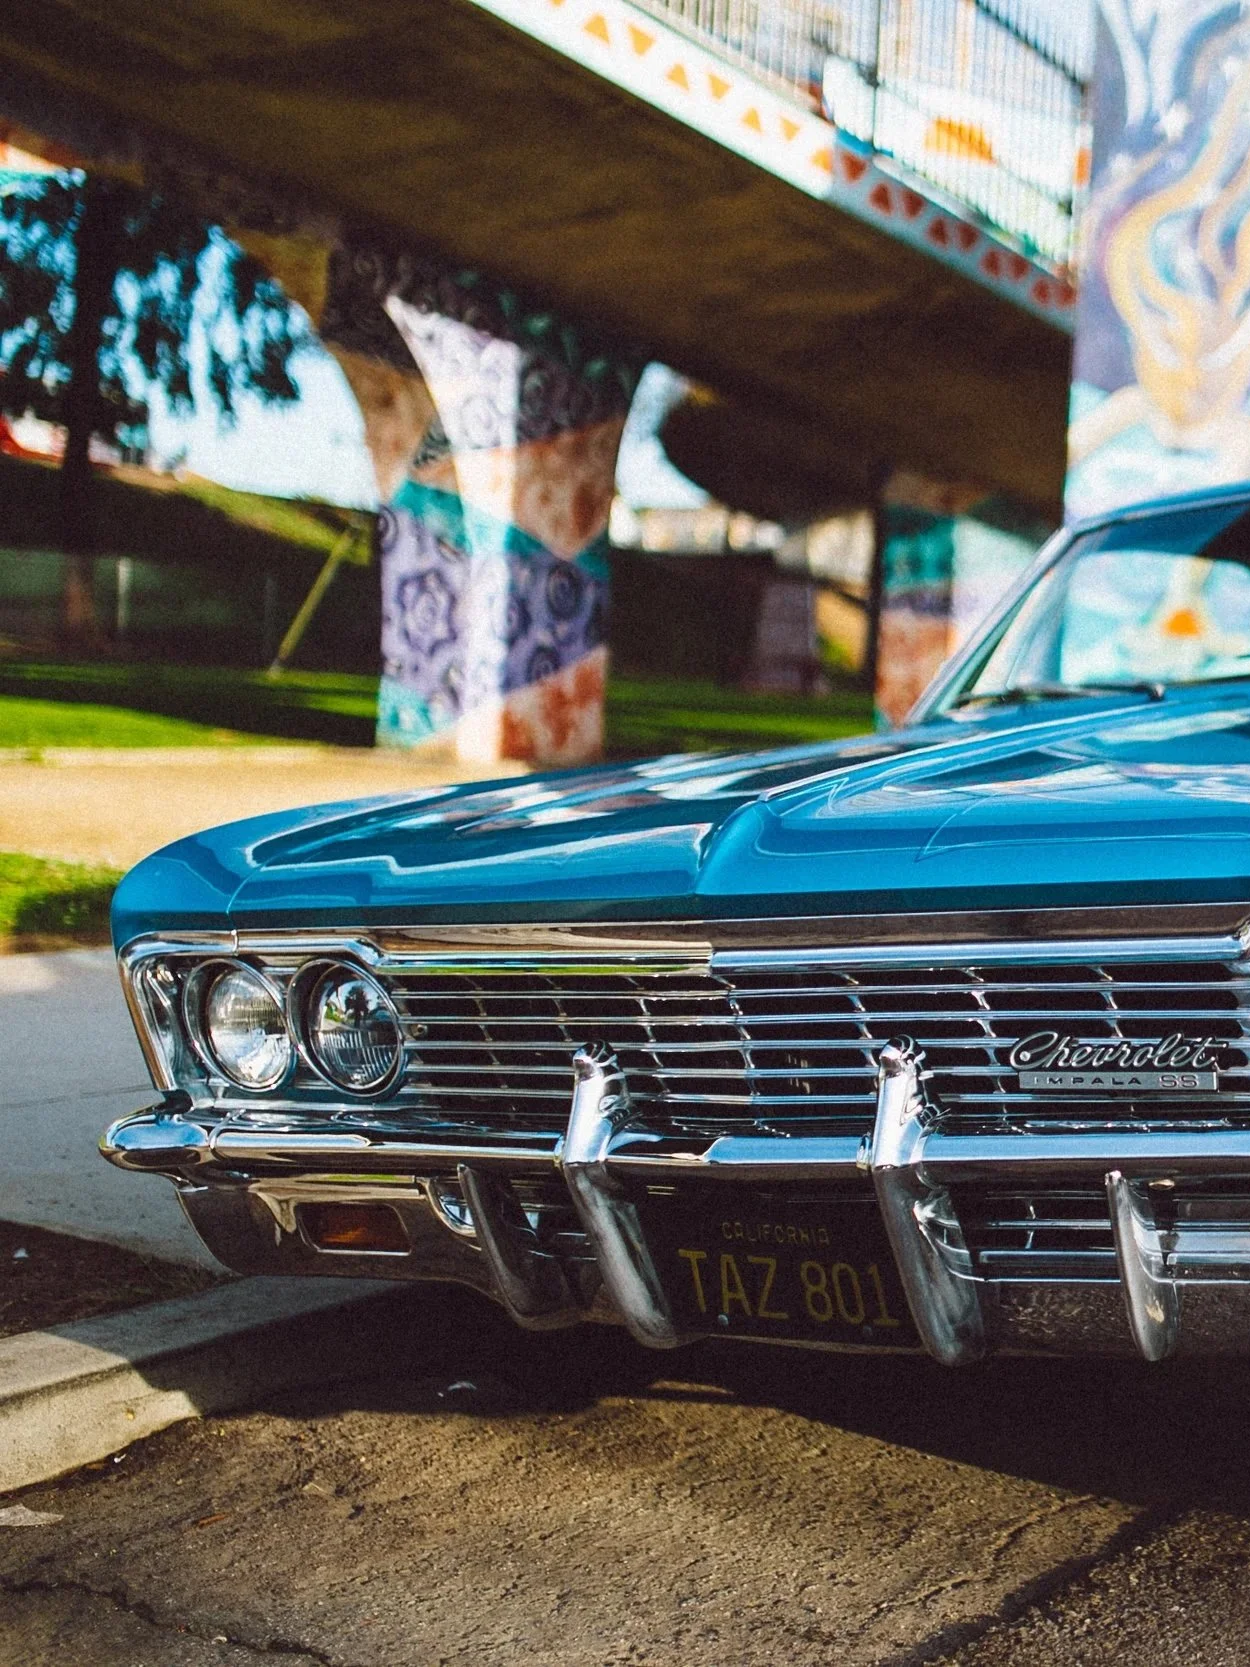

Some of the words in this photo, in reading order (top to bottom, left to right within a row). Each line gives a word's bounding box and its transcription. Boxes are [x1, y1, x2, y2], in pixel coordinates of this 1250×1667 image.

[1010, 1030, 1229, 1070] Chevrolet
[1033, 1076, 1143, 1087] IMPALA
[1158, 1074, 1200, 1089] SS
[721, 1221, 831, 1246] CALIFORNIA
[678, 1249, 789, 1320] TAZ
[800, 1259, 900, 1327] 801
